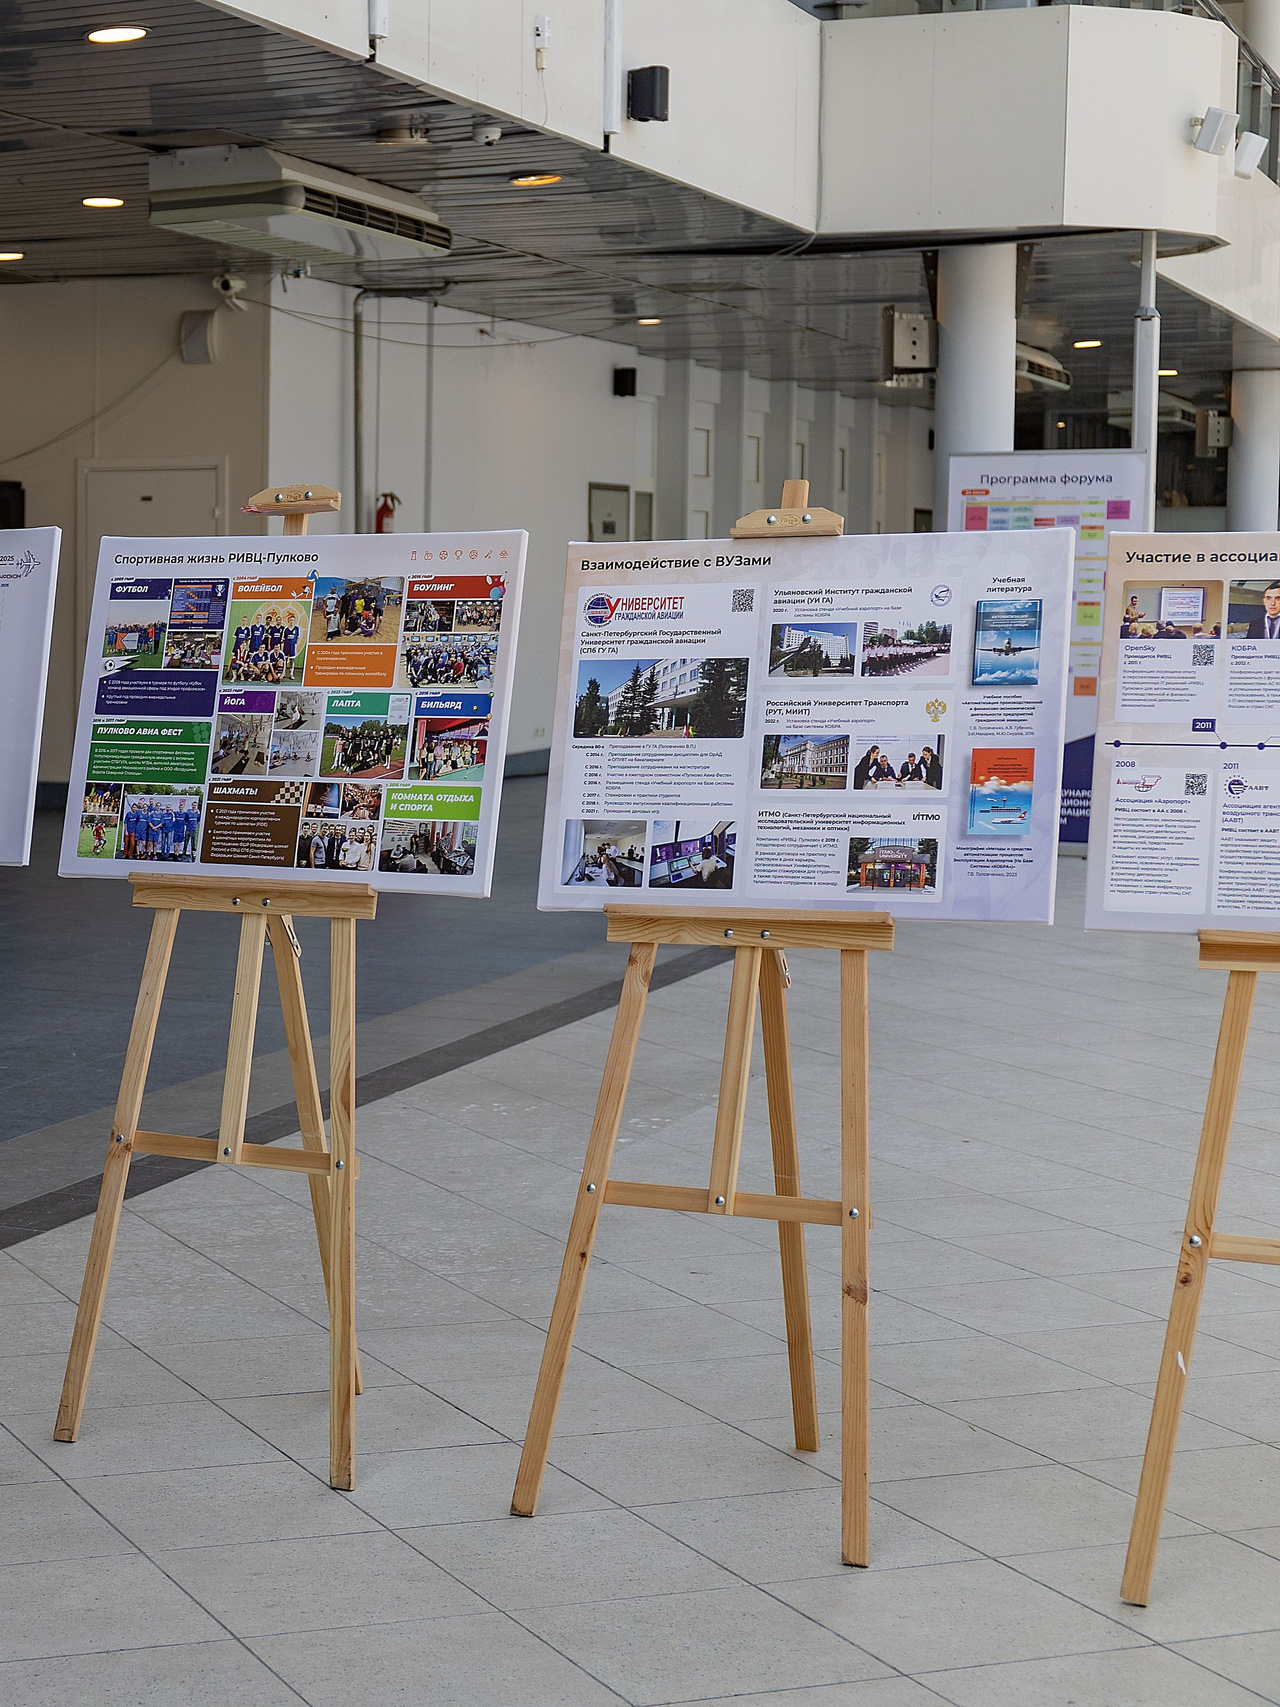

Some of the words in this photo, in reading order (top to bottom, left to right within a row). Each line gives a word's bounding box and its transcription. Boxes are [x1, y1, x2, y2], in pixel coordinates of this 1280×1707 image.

[981, 474, 1055, 484] Программа
[1060, 474, 1112, 484] форума
[115, 554, 183, 566] Спортивная
[187, 556, 224, 564] жизнь
[228, 553, 318, 566] РИВЦ-Пулково
[1126, 551, 1191, 563] Участие
[1197, 553, 1205, 562] в
[1210, 552, 1280, 563] ассоциа
[581, 557, 698, 572] Взаимодействие
[704, 559, 710, 567] с
[716, 555, 771, 566] ВУЗами
[238, 583, 282, 592] ВОЛЕЙБОЛ
[413, 583, 454, 591] БОУЛИНГ
[823, 588, 858, 596] Институт
[861, 587, 912, 595] гражданской
[604, 597, 684, 620] УНИВЕРСИТЕТ
[615, 611, 656, 621] ГРАЖДАНСКОЙ
[657, 611, 684, 620] АВИАЦИИ
[581, 630, 657, 638] Санкт-Петербургский
[658, 629, 721, 637] Государственный
[580, 638, 624, 646] Университет
[626, 638, 673, 646] гражданской
[1125, 645, 1156, 653] OpenSky
[224, 697, 245, 706] ЙОГА
[421, 701, 462, 710] БИЛЬЯРД
[813, 700, 861, 708] Университет
[97, 727, 135, 735] ПУЛКОВО
[213, 787, 258, 795] ШАХМАТЫ
[391, 793, 434, 801] КОМНАТА
[436, 794, 474, 802] ОТДЫХА
